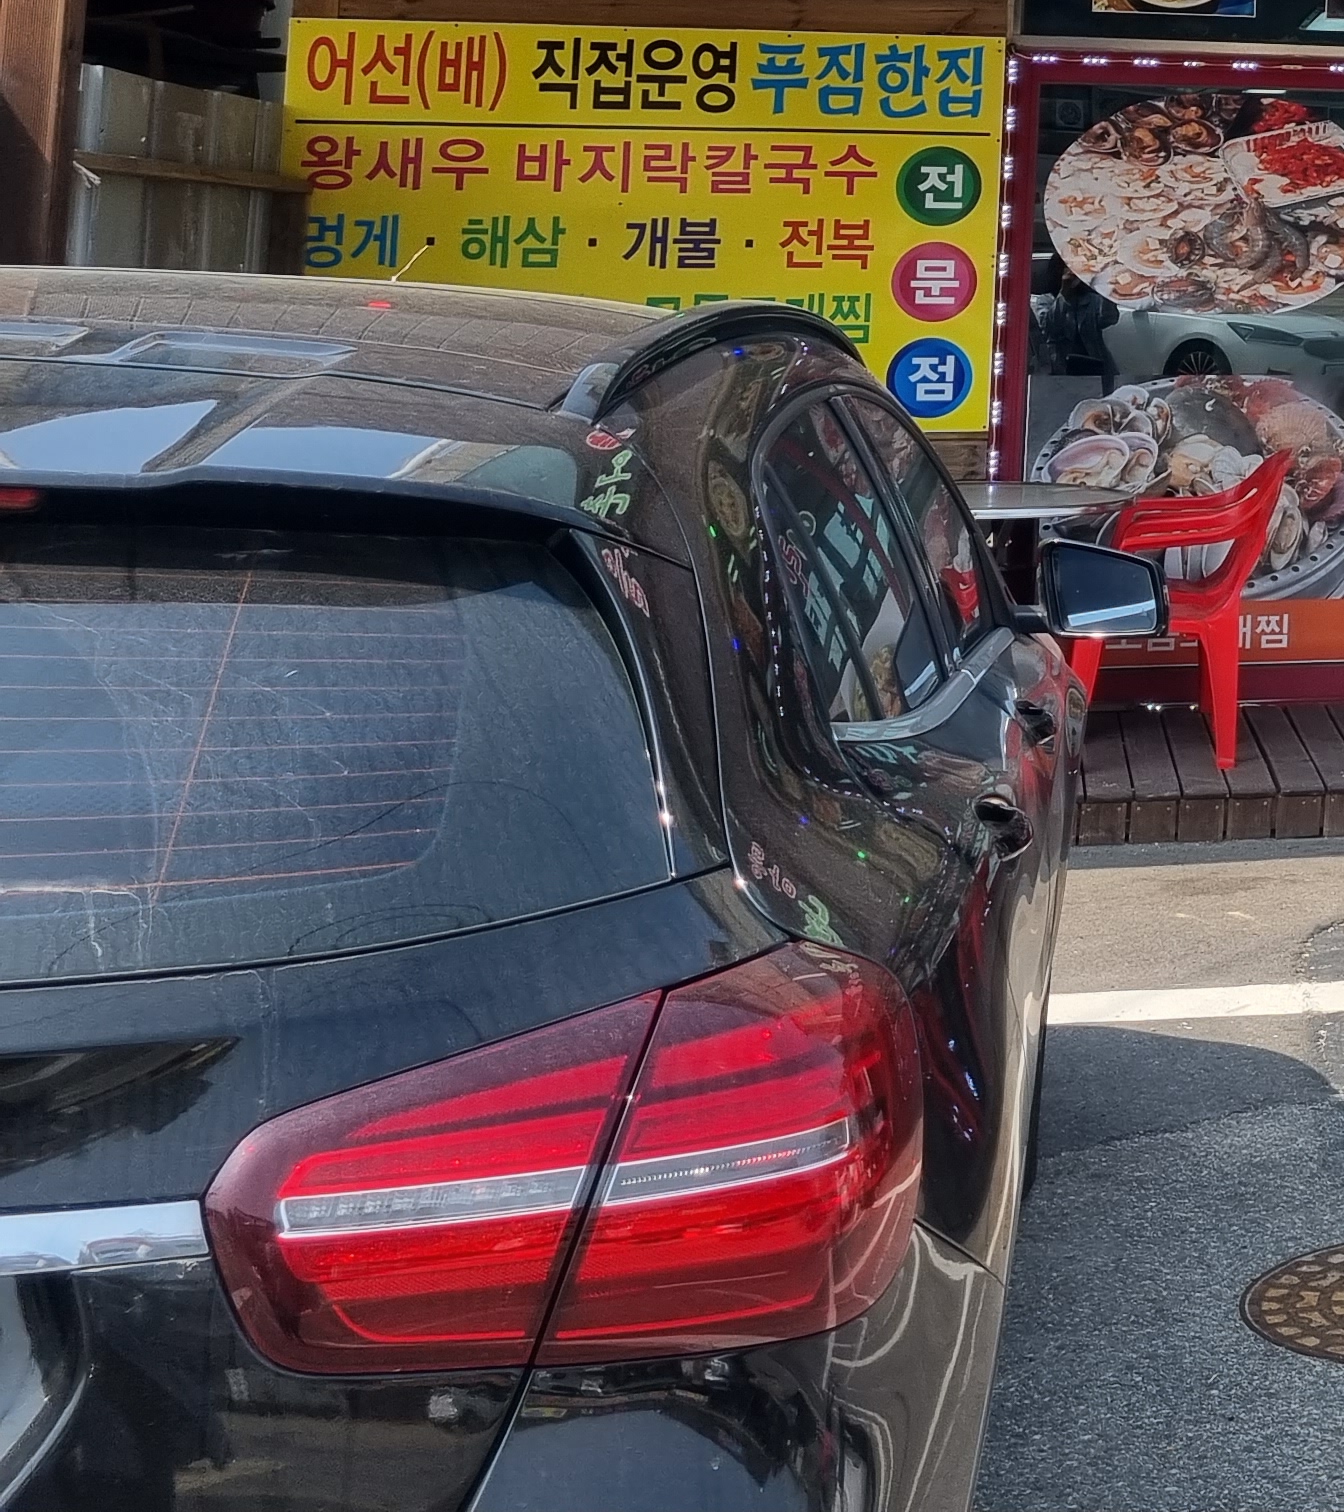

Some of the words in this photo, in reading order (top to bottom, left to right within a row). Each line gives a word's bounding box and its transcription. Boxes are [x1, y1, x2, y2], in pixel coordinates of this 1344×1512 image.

[306, 29, 507, 111] 어선(배)
[532, 36, 738, 114] 직접운영
[751, 42, 984, 119] 푸짐한집
[301, 135, 490, 191] 왕새우
[515, 140, 880, 196] 바지락칼국수
[305, 212, 400, 268] 멍게
[460, 215, 567, 270] 해삼
[623, 216, 723, 271] 개불
[778, 218, 876, 272] 전복
